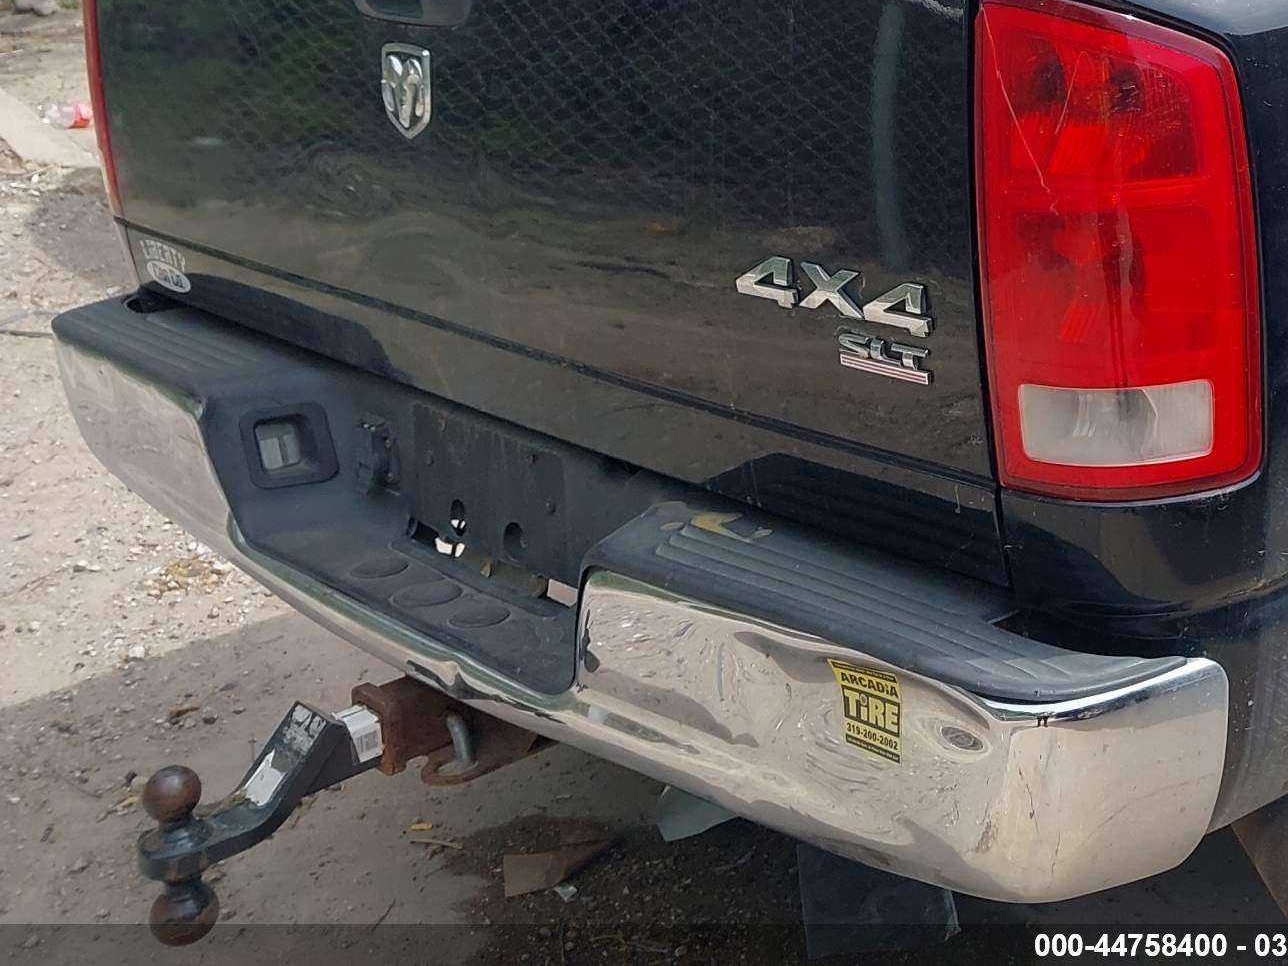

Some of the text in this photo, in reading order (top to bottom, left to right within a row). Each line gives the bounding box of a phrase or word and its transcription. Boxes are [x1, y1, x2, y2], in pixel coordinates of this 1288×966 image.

[140, 239, 186, 273] LIBERTY
[735, 255, 934, 338] 4X4
[838, 332, 930, 371] SLT
